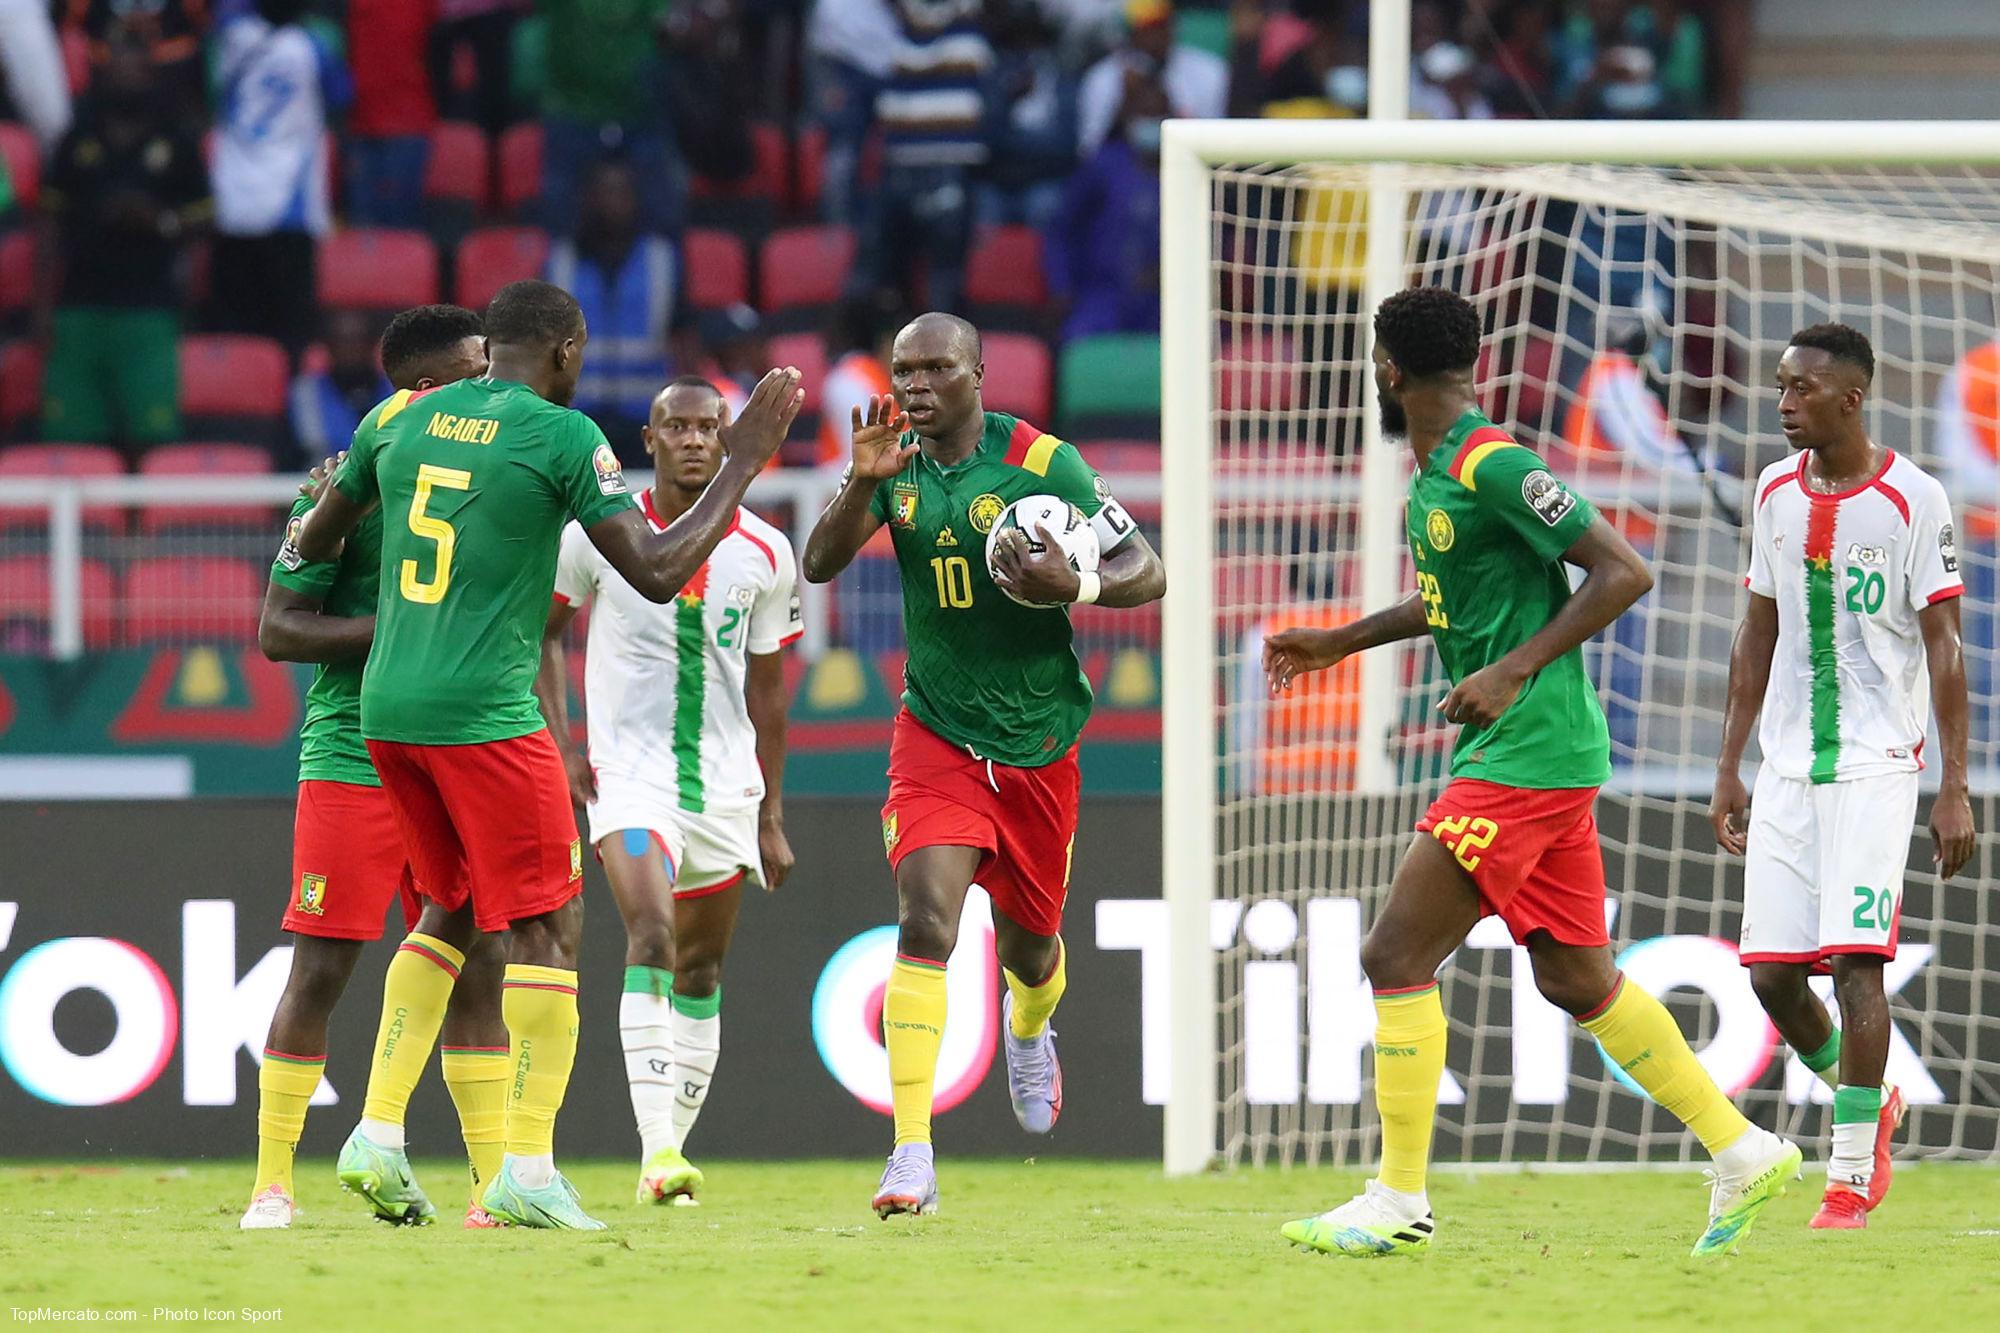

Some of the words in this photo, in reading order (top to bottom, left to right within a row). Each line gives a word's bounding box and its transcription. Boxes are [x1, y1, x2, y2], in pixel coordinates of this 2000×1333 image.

[426, 411, 499, 445] NGADEU
[399, 463, 472, 605] 5
[1102, 504, 1129, 536] C
[930, 556, 974, 609] 10
[1416, 571, 1449, 629] 22
[1846, 566, 1886, 615] 20
[1432, 815, 1499, 872] 22
[1853, 886, 1892, 931] 20
[0, 898, 340, 1107] ok
